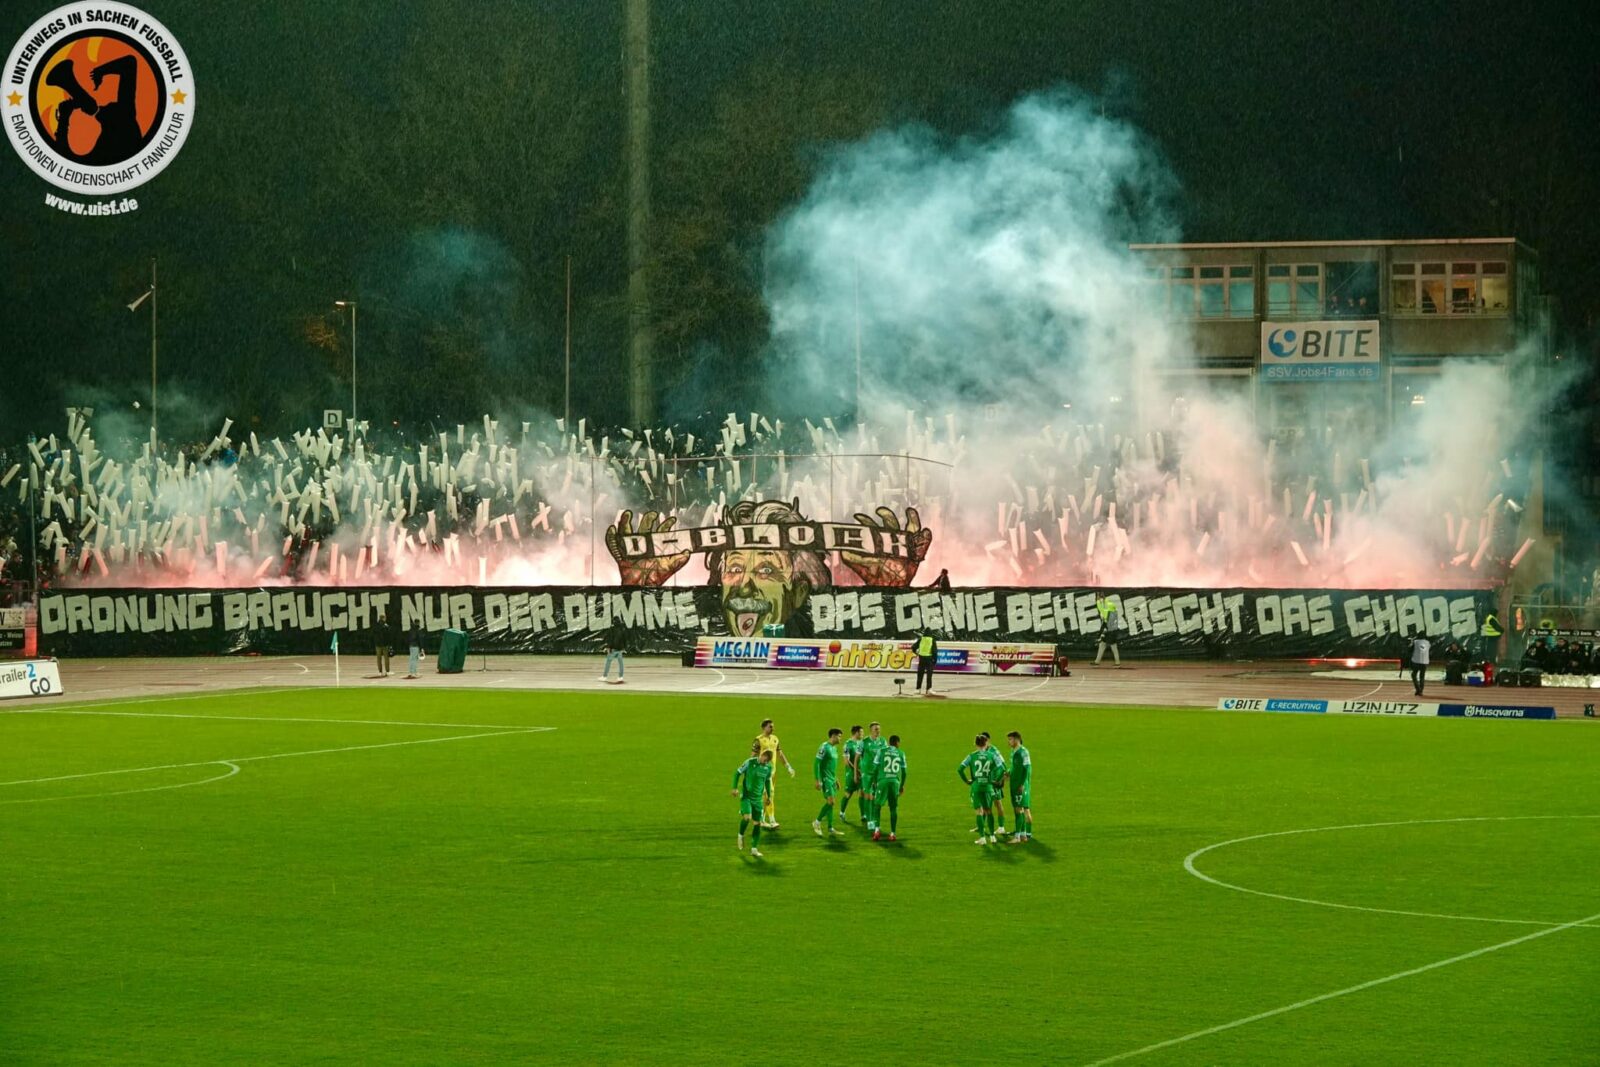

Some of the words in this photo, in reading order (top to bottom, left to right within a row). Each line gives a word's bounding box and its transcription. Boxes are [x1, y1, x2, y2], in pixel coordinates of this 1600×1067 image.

[1301, 329, 1373, 358] BITE
[327, 412, 338, 425] D
[40, 592, 213, 634] ORDNUNG
[222, 591, 390, 632] BRAUCHT
[401, 591, 476, 632] NUR
[484, 592, 556, 633] DER
[809, 591, 887, 633] DAS
[895, 591, 999, 633] GENIE
[1255, 594, 1336, 636] DAS
[1343, 594, 1478, 639] CHAOS
[0, 669, 26, 684] railer
[30, 677, 50, 695] GO
[1235, 698, 1262, 710] BITE
[1271, 702, 1322, 711] E-RECRUITING
[1475, 707, 1525, 717] Husqvarna
[883, 756, 901, 773] 26
[974, 760, 991, 777] 24
